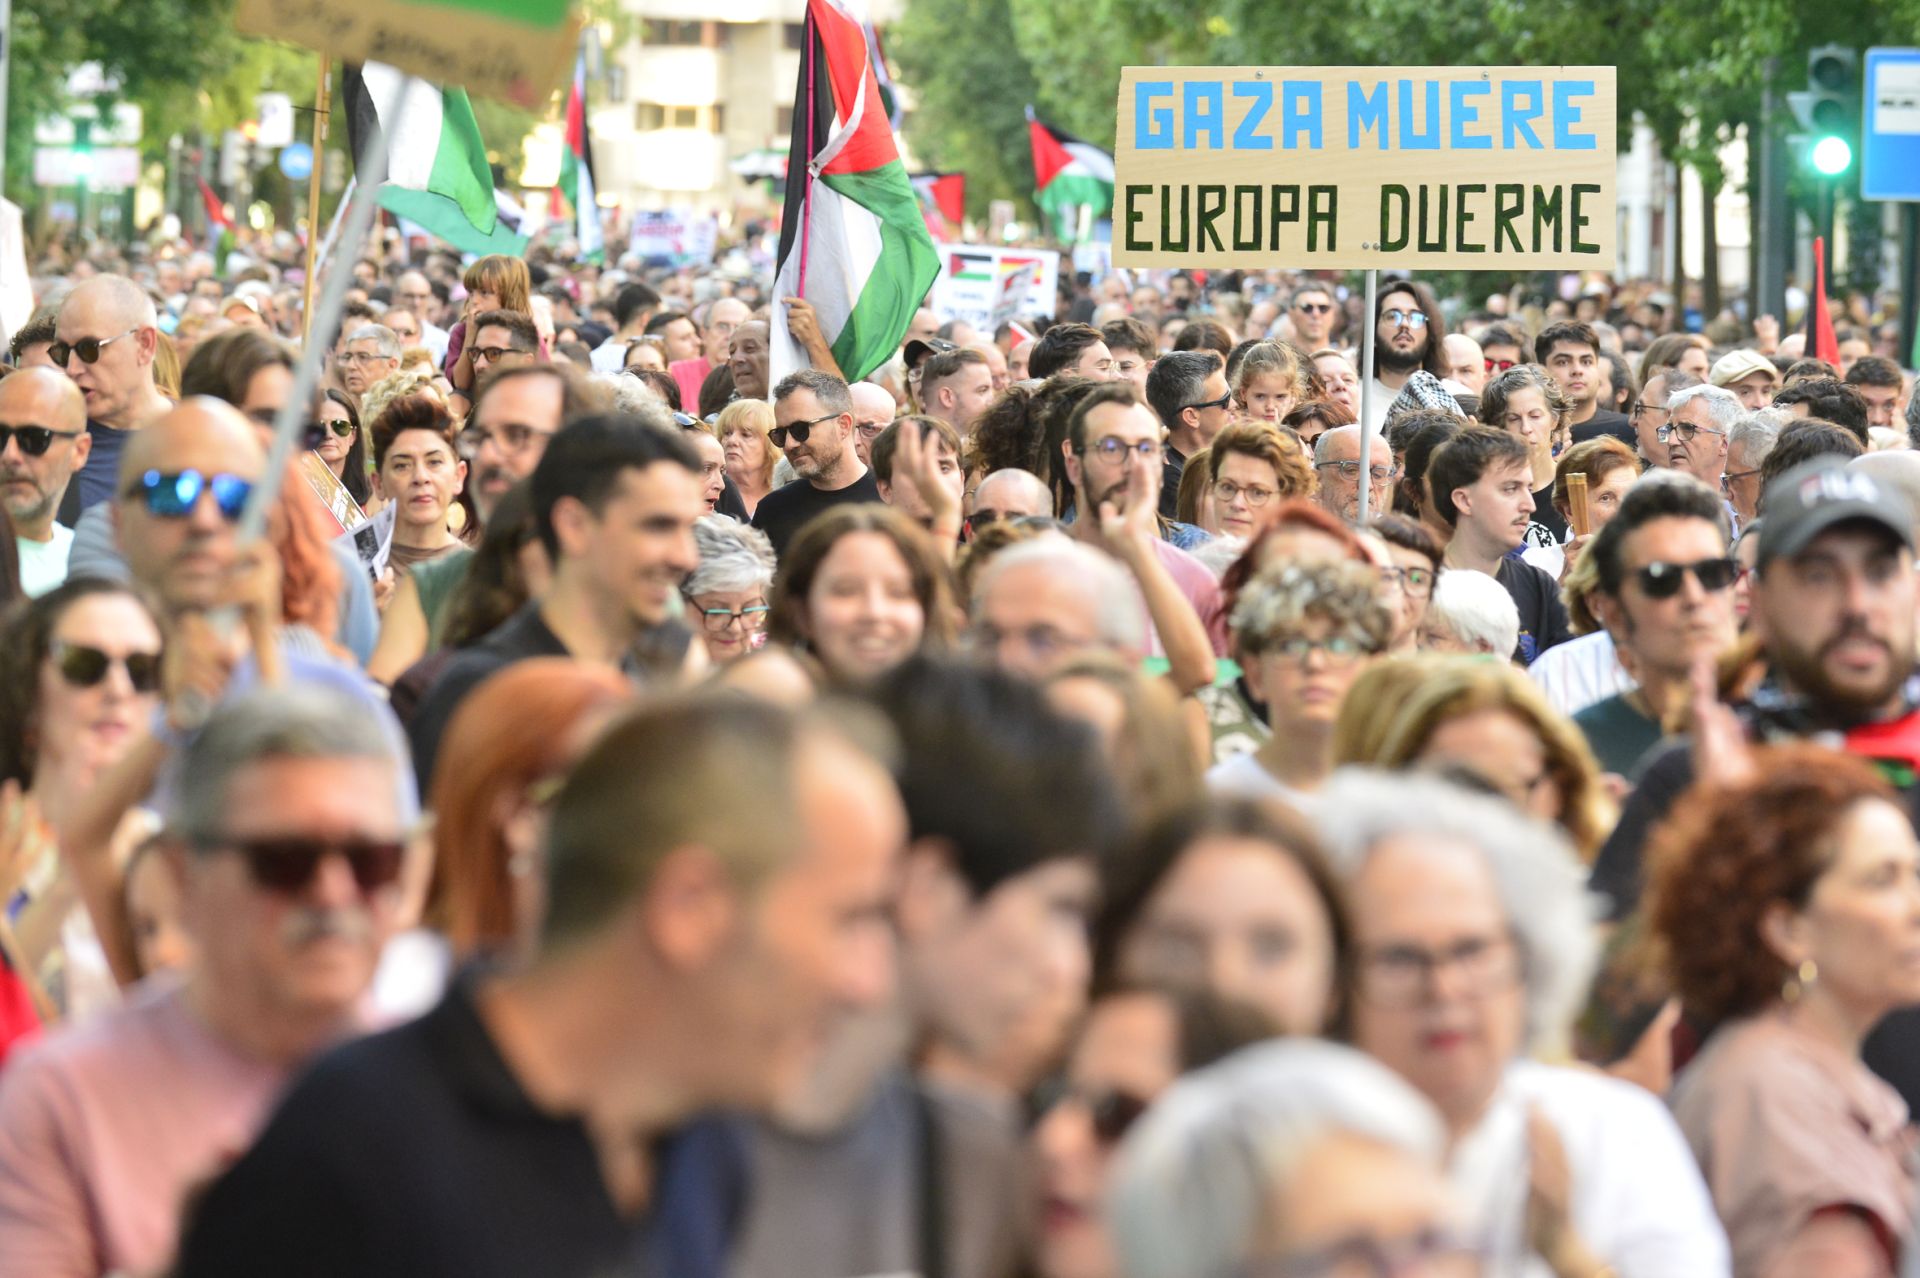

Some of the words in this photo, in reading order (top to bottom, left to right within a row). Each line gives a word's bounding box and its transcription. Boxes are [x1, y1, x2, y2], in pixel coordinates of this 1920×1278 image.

[1134, 81, 1323, 150] GAZA
[1346, 80, 1598, 150] MUERE
[1125, 184, 1338, 252] EUROPA
[1379, 184, 1602, 254] DUERME
